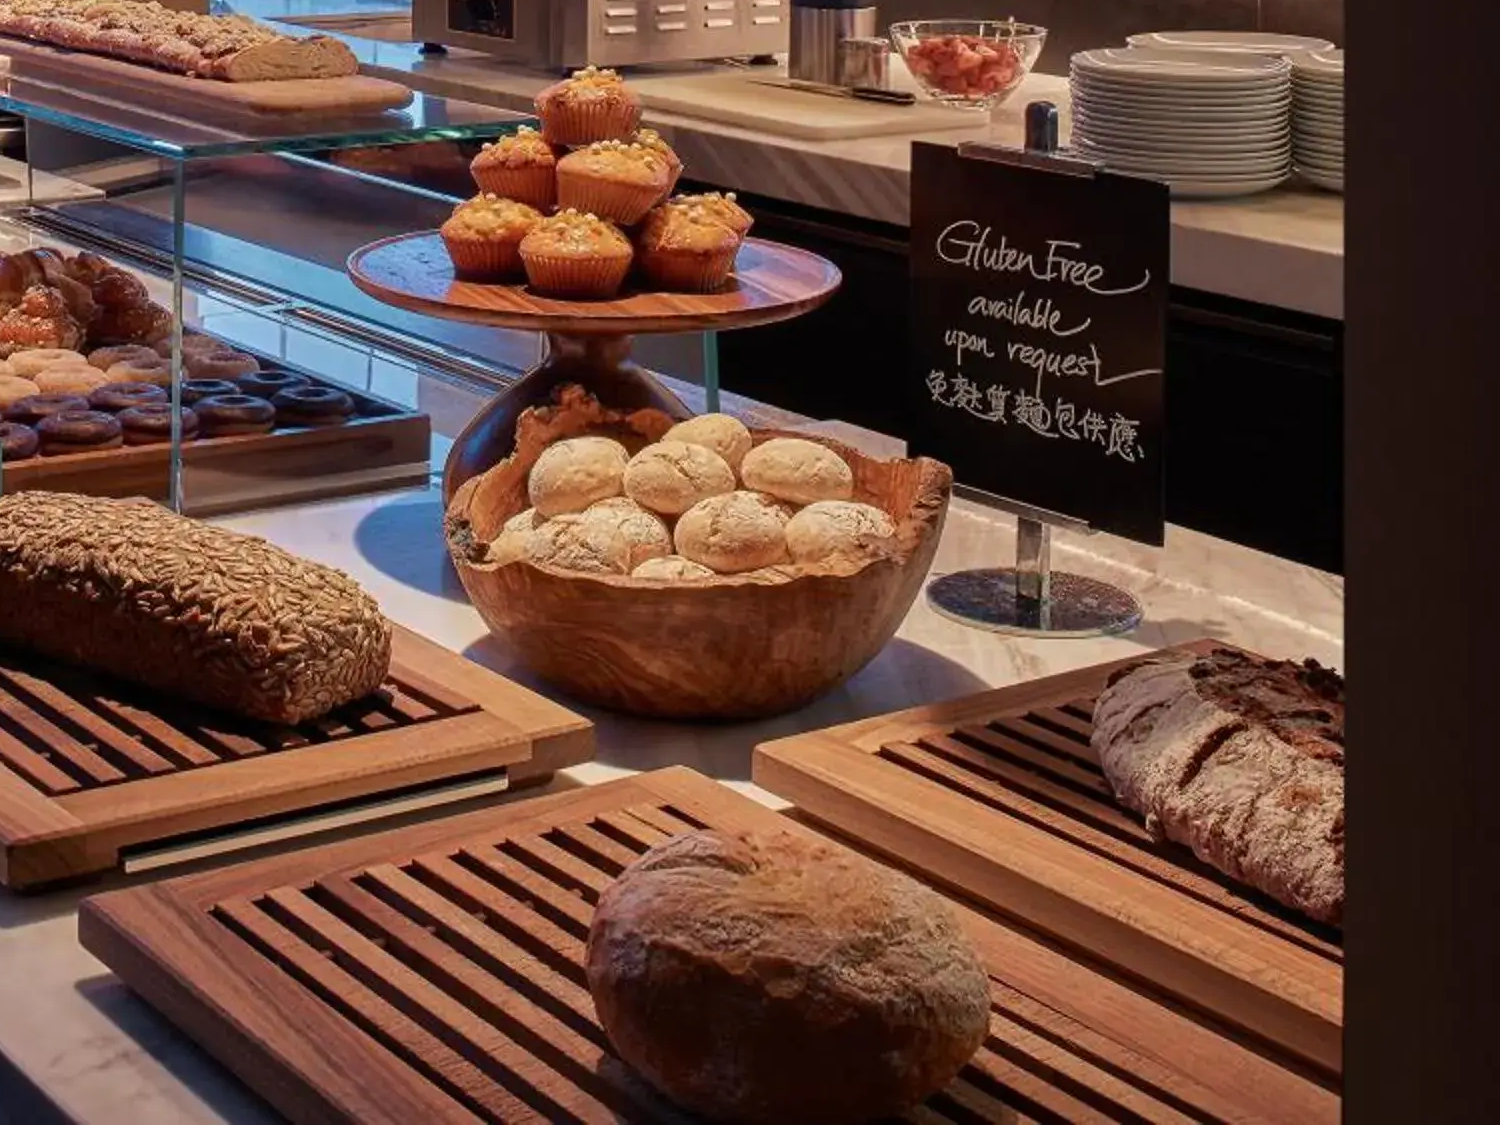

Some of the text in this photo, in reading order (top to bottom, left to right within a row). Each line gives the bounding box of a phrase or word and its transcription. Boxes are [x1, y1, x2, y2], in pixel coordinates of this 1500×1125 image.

[937, 220, 1151, 295] Gluten Free
[967, 290, 1091, 336] available
[945, 328, 1163, 399] upon request
